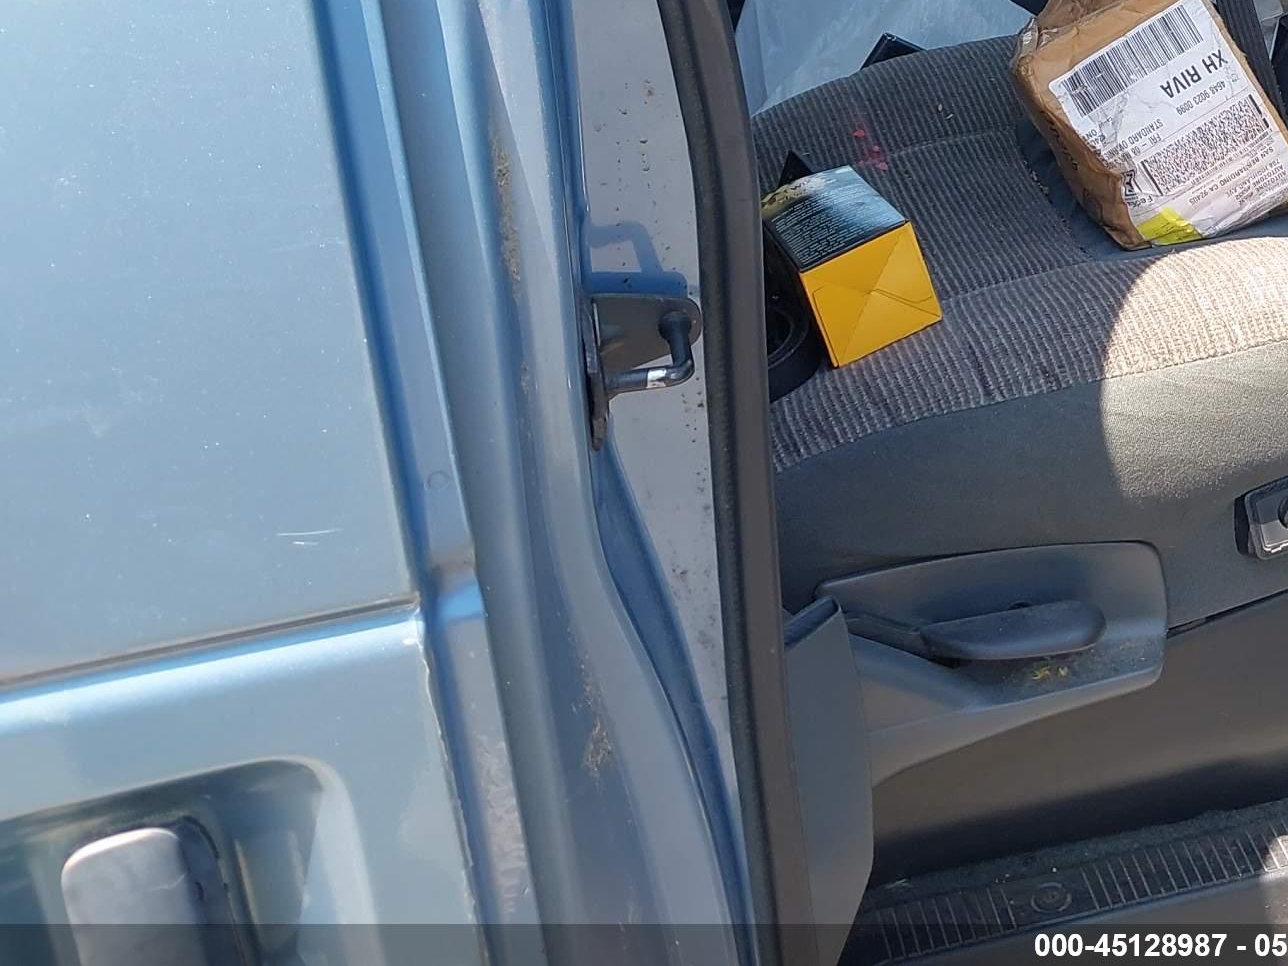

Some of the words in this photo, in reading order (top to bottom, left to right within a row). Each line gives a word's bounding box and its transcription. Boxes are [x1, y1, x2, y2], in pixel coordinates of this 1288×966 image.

[1200, 47, 1228, 74] XH
[1158, 64, 1202, 100] RIVA
[1208, 78, 1226, 95] 4648
[1191, 88, 1210, 105] 9023
[1174, 98, 1194, 116] 0099
[1126, 117, 1163, 145] STANDARD
[1146, 132, 1161, 145] FRI
[1130, 145, 1141, 156] 08
[1258, 145, 1275, 159] SAN
[1217, 155, 1261, 187] BERNARDINO
[1249, 163, 1285, 189] AUTOZONE
[1207, 182, 1219, 193] CA
[1252, 168, 1288, 194] AUTOZONE
[1224, 185, 1238, 198] AVE
